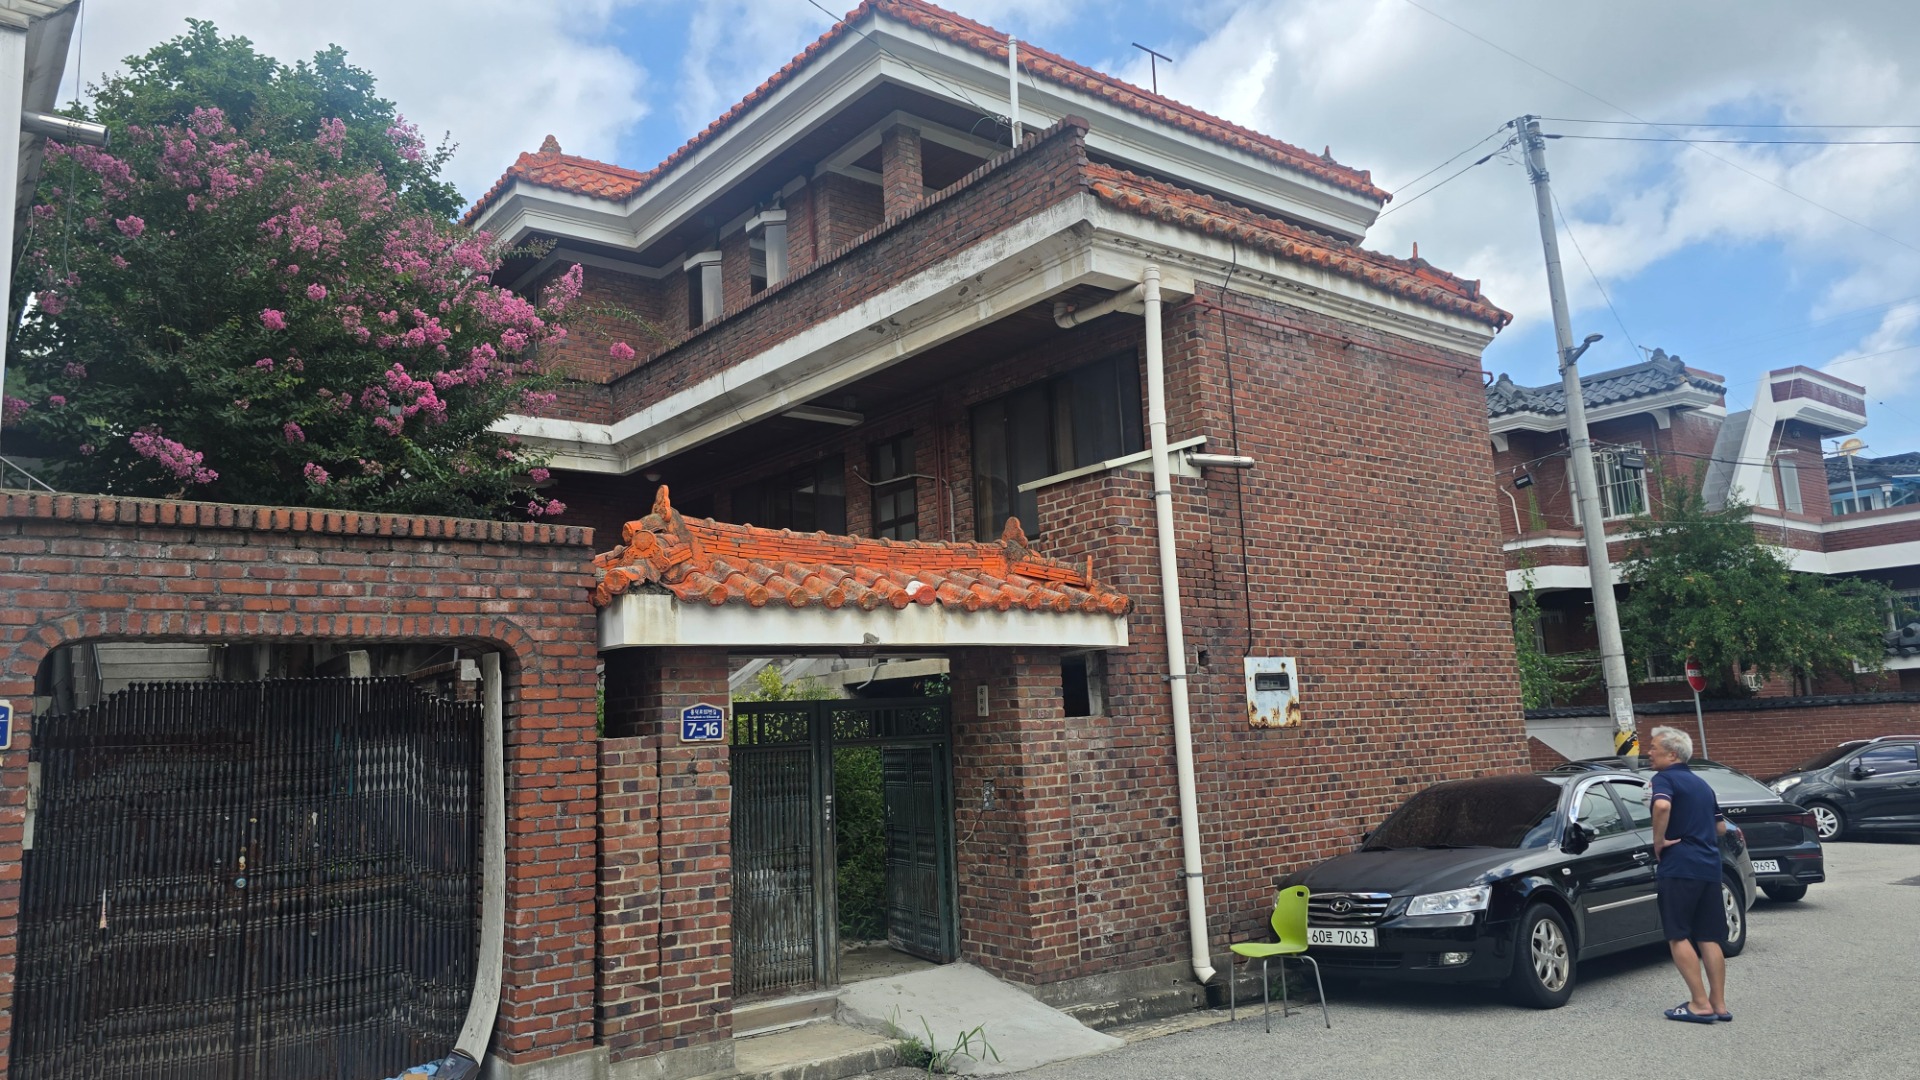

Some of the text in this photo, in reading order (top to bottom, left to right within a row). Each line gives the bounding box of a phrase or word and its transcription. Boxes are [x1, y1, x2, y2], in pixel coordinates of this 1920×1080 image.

[687, 721, 719, 737] 7-16
[1753, 861, 1777, 871] 9693
[1311, 929, 1368, 944] 60로 7063
